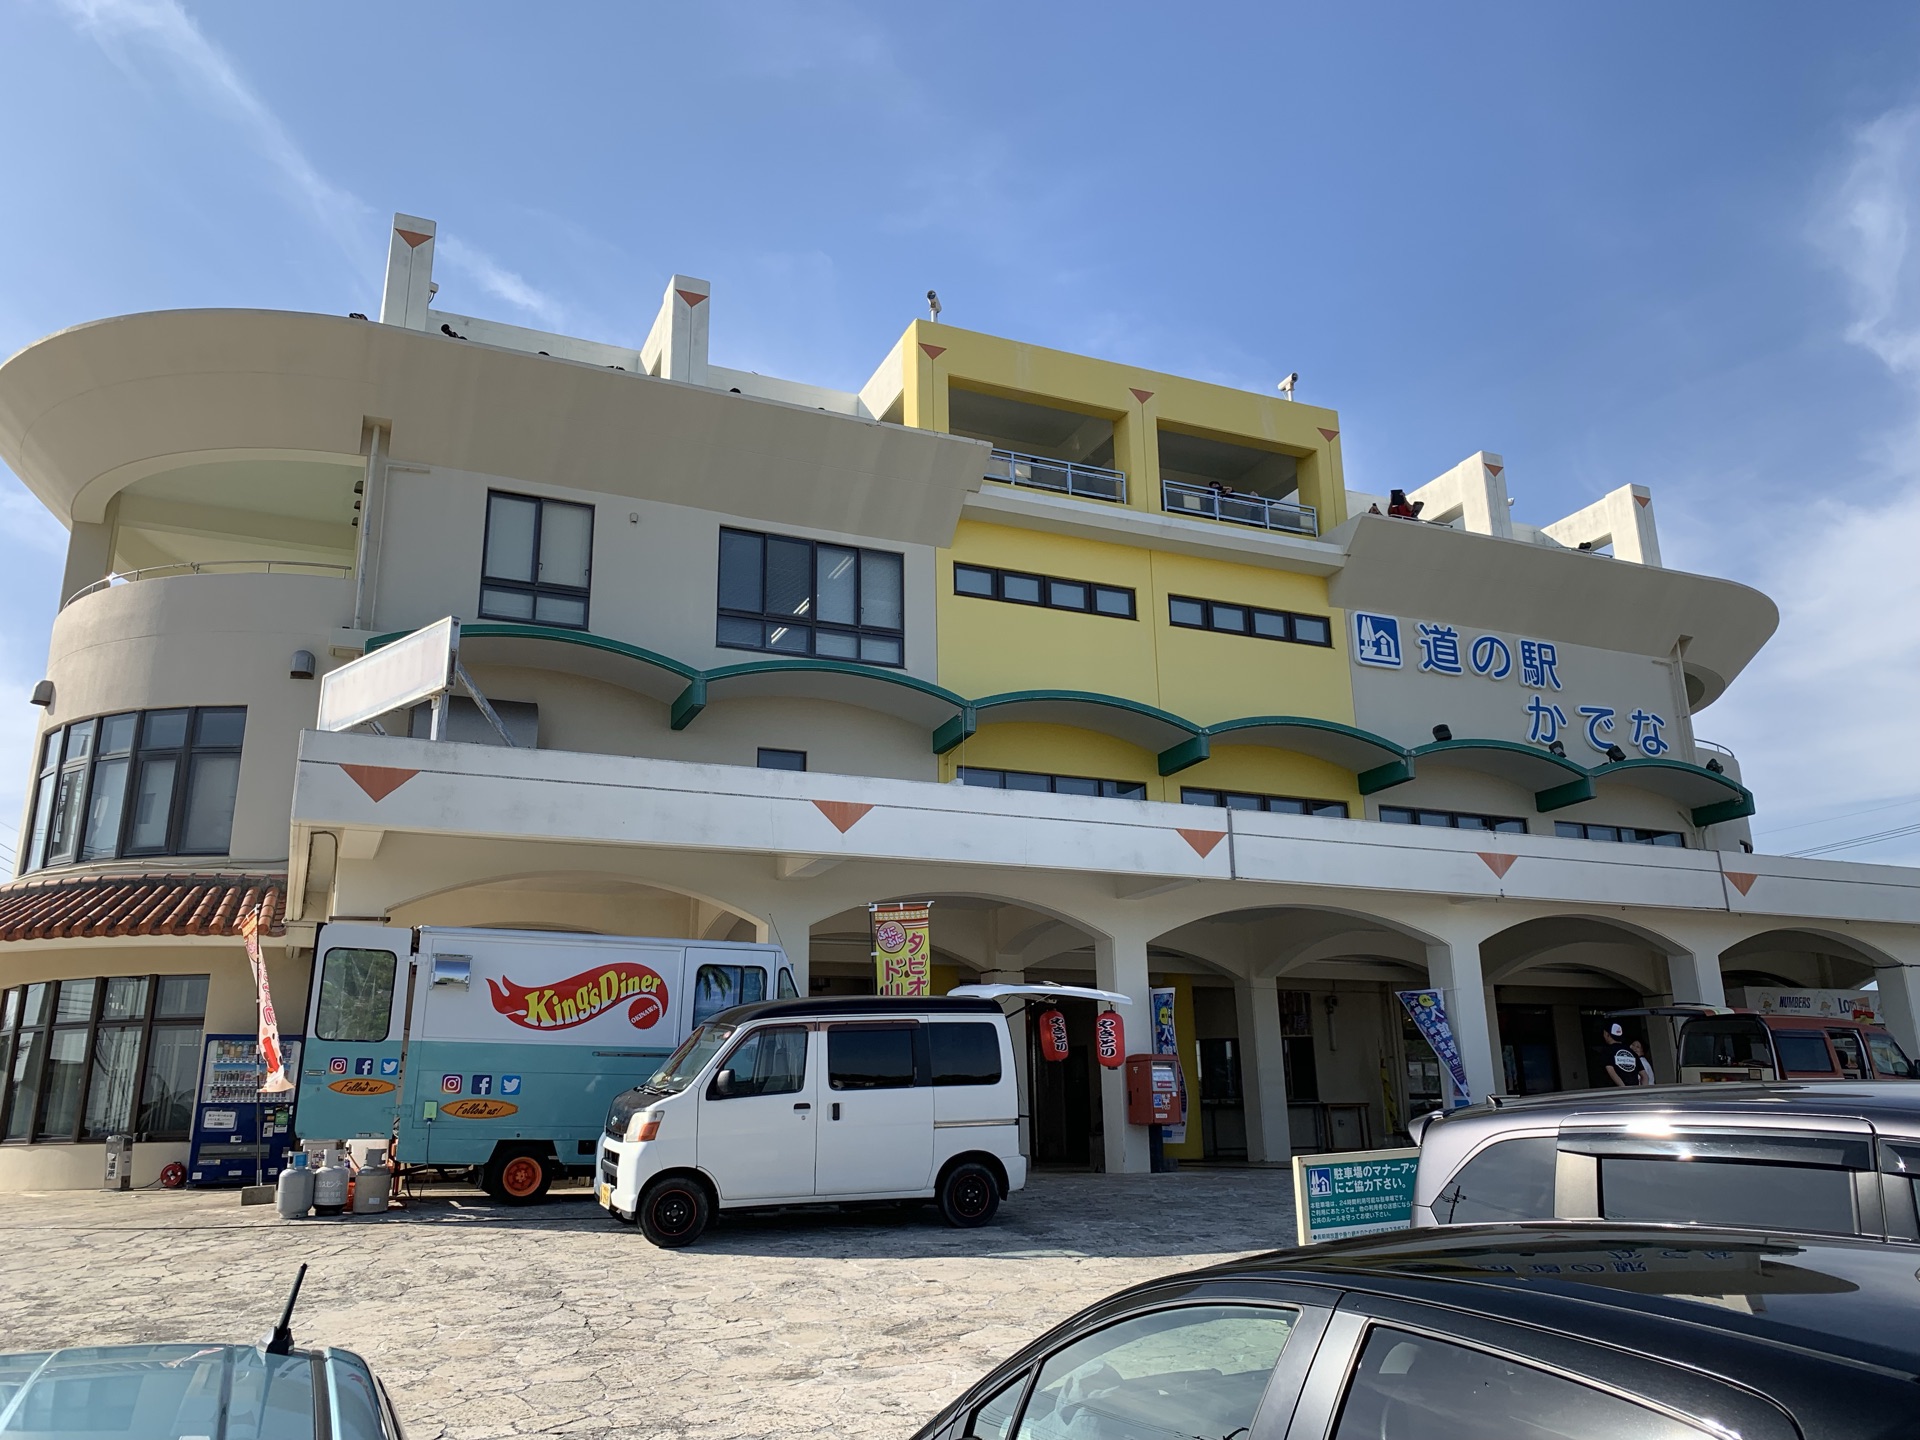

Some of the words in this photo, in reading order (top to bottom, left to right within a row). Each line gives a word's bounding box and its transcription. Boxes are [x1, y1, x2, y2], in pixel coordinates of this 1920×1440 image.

[1415, 622, 1563, 692] 道の駅
[1523, 694, 1670, 758] かでな
[907, 932, 928, 996] タピオ
[1779, 996, 1811, 1009] NUMBERS
[630, 1004, 658, 1024] OKINAWA
[1097, 1018, 1117, 1058] やきとり
[340, 1081, 368, 1093] Follow
[455, 1102, 487, 1116] Follow
[1334, 1178, 1407, 1194] にご協力下さい。
